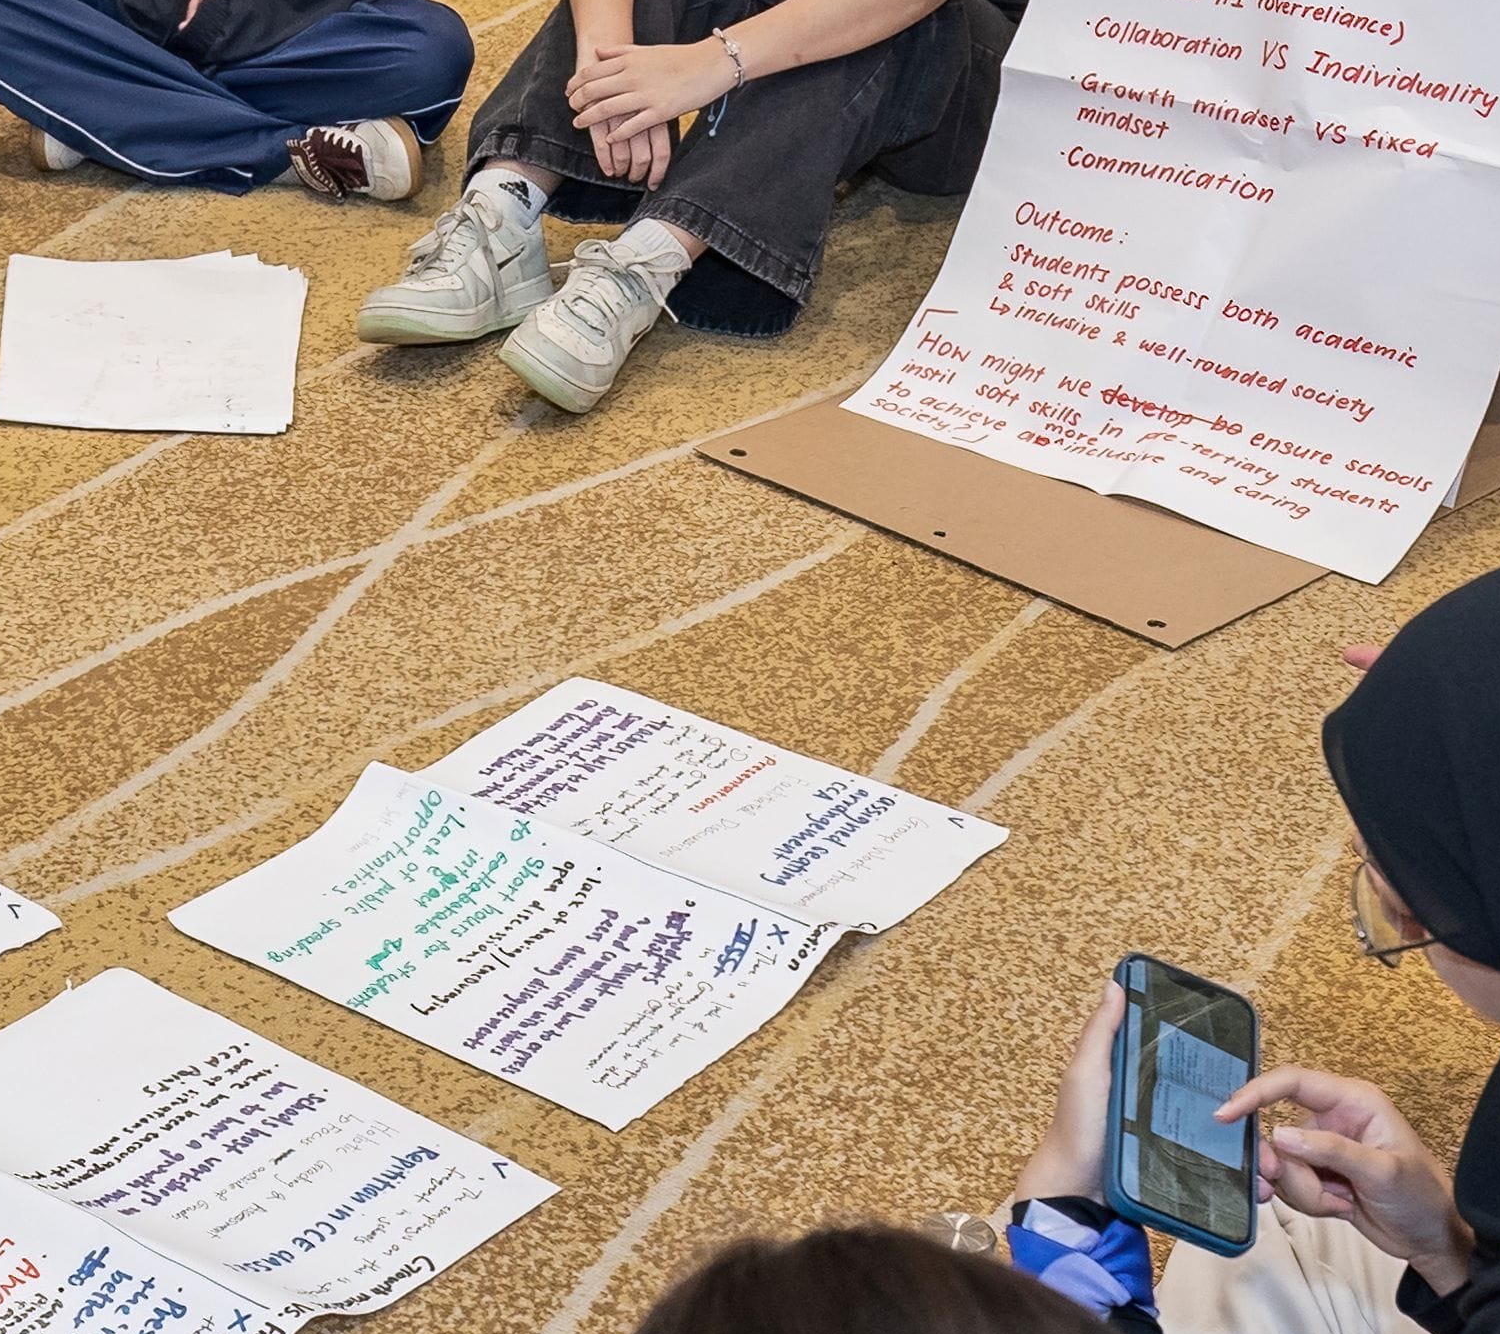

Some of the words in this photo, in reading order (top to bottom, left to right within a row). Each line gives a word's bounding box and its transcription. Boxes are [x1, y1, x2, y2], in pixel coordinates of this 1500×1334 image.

[1093, 15, 1243, 61] Collaboration
[1260, 39, 1289, 71] VS
[1304, 49, 1499, 119] Individuality
[1075, 105, 1170, 139] mindset
[1079, 71, 1175, 109] Growth
[1191, 98, 1295, 135] mindset
[1314, 120, 1347, 145] VS
[1361, 128, 1439, 159] fixed
[1066, 144, 1274, 204] Communication
[996, 270, 1014, 292] &
[1023, 279, 1073, 302] soft
[1083, 292, 1141, 320] skills
[1009, 242, 1111, 284] Students
[1113, 273, 1210, 310] possess
[1220, 298, 1279, 330] both
[1294, 323, 1418, 369] academic
[1013, 304, 1101, 340] inclusive
[1111, 329, 1127, 347] &
[1137, 338, 1288, 394] well-rounded
[1290, 383, 1375, 423] society
[916, 329, 971, 363] How
[979, 353, 1046, 386] might
[1056, 374, 1092, 398] we
[1248, 431, 1333, 465] ensure
[1345, 455, 1434, 496] schools
[1043, 421, 1098, 446] more
[885, 379, 911, 398] to
[918, 395, 1007, 431] achieve
[1069, 427, 1165, 464] inclusive
[1177, 464, 1225, 486] and
[1232, 484, 1311, 520] caring
[974, 382, 1020, 407] soft
[1027, 400, 1082, 427] skills
[1097, 416, 1124, 438] in
[1289, 476, 1400, 514] students
[686, 754, 777, 814] Presentations
[811, 780, 848, 801] CCA
[421, 812, 466, 856] Lack
[771, 787, 869, 861] arrangement
[808, 793, 896, 848] assigned
[397, 861, 419, 883] of
[496, 855, 545, 903] Short
[542, 859, 575, 893] open
[758, 842, 829, 886] seating
[343, 876, 397, 915] public
[566, 876, 602, 908] lack
[265, 917, 342, 963] speaking
[449, 902, 504, 938] hours
[422, 938, 451, 959] for
[346, 960, 417, 1008] students
[139, 1156, 223, 1207] workshops
[326, 1203, 355, 1221] in
[290, 1220, 337, 1253] CCE
[72, 1268, 134, 1329] better
[368, 1254, 436, 1296] Growth
